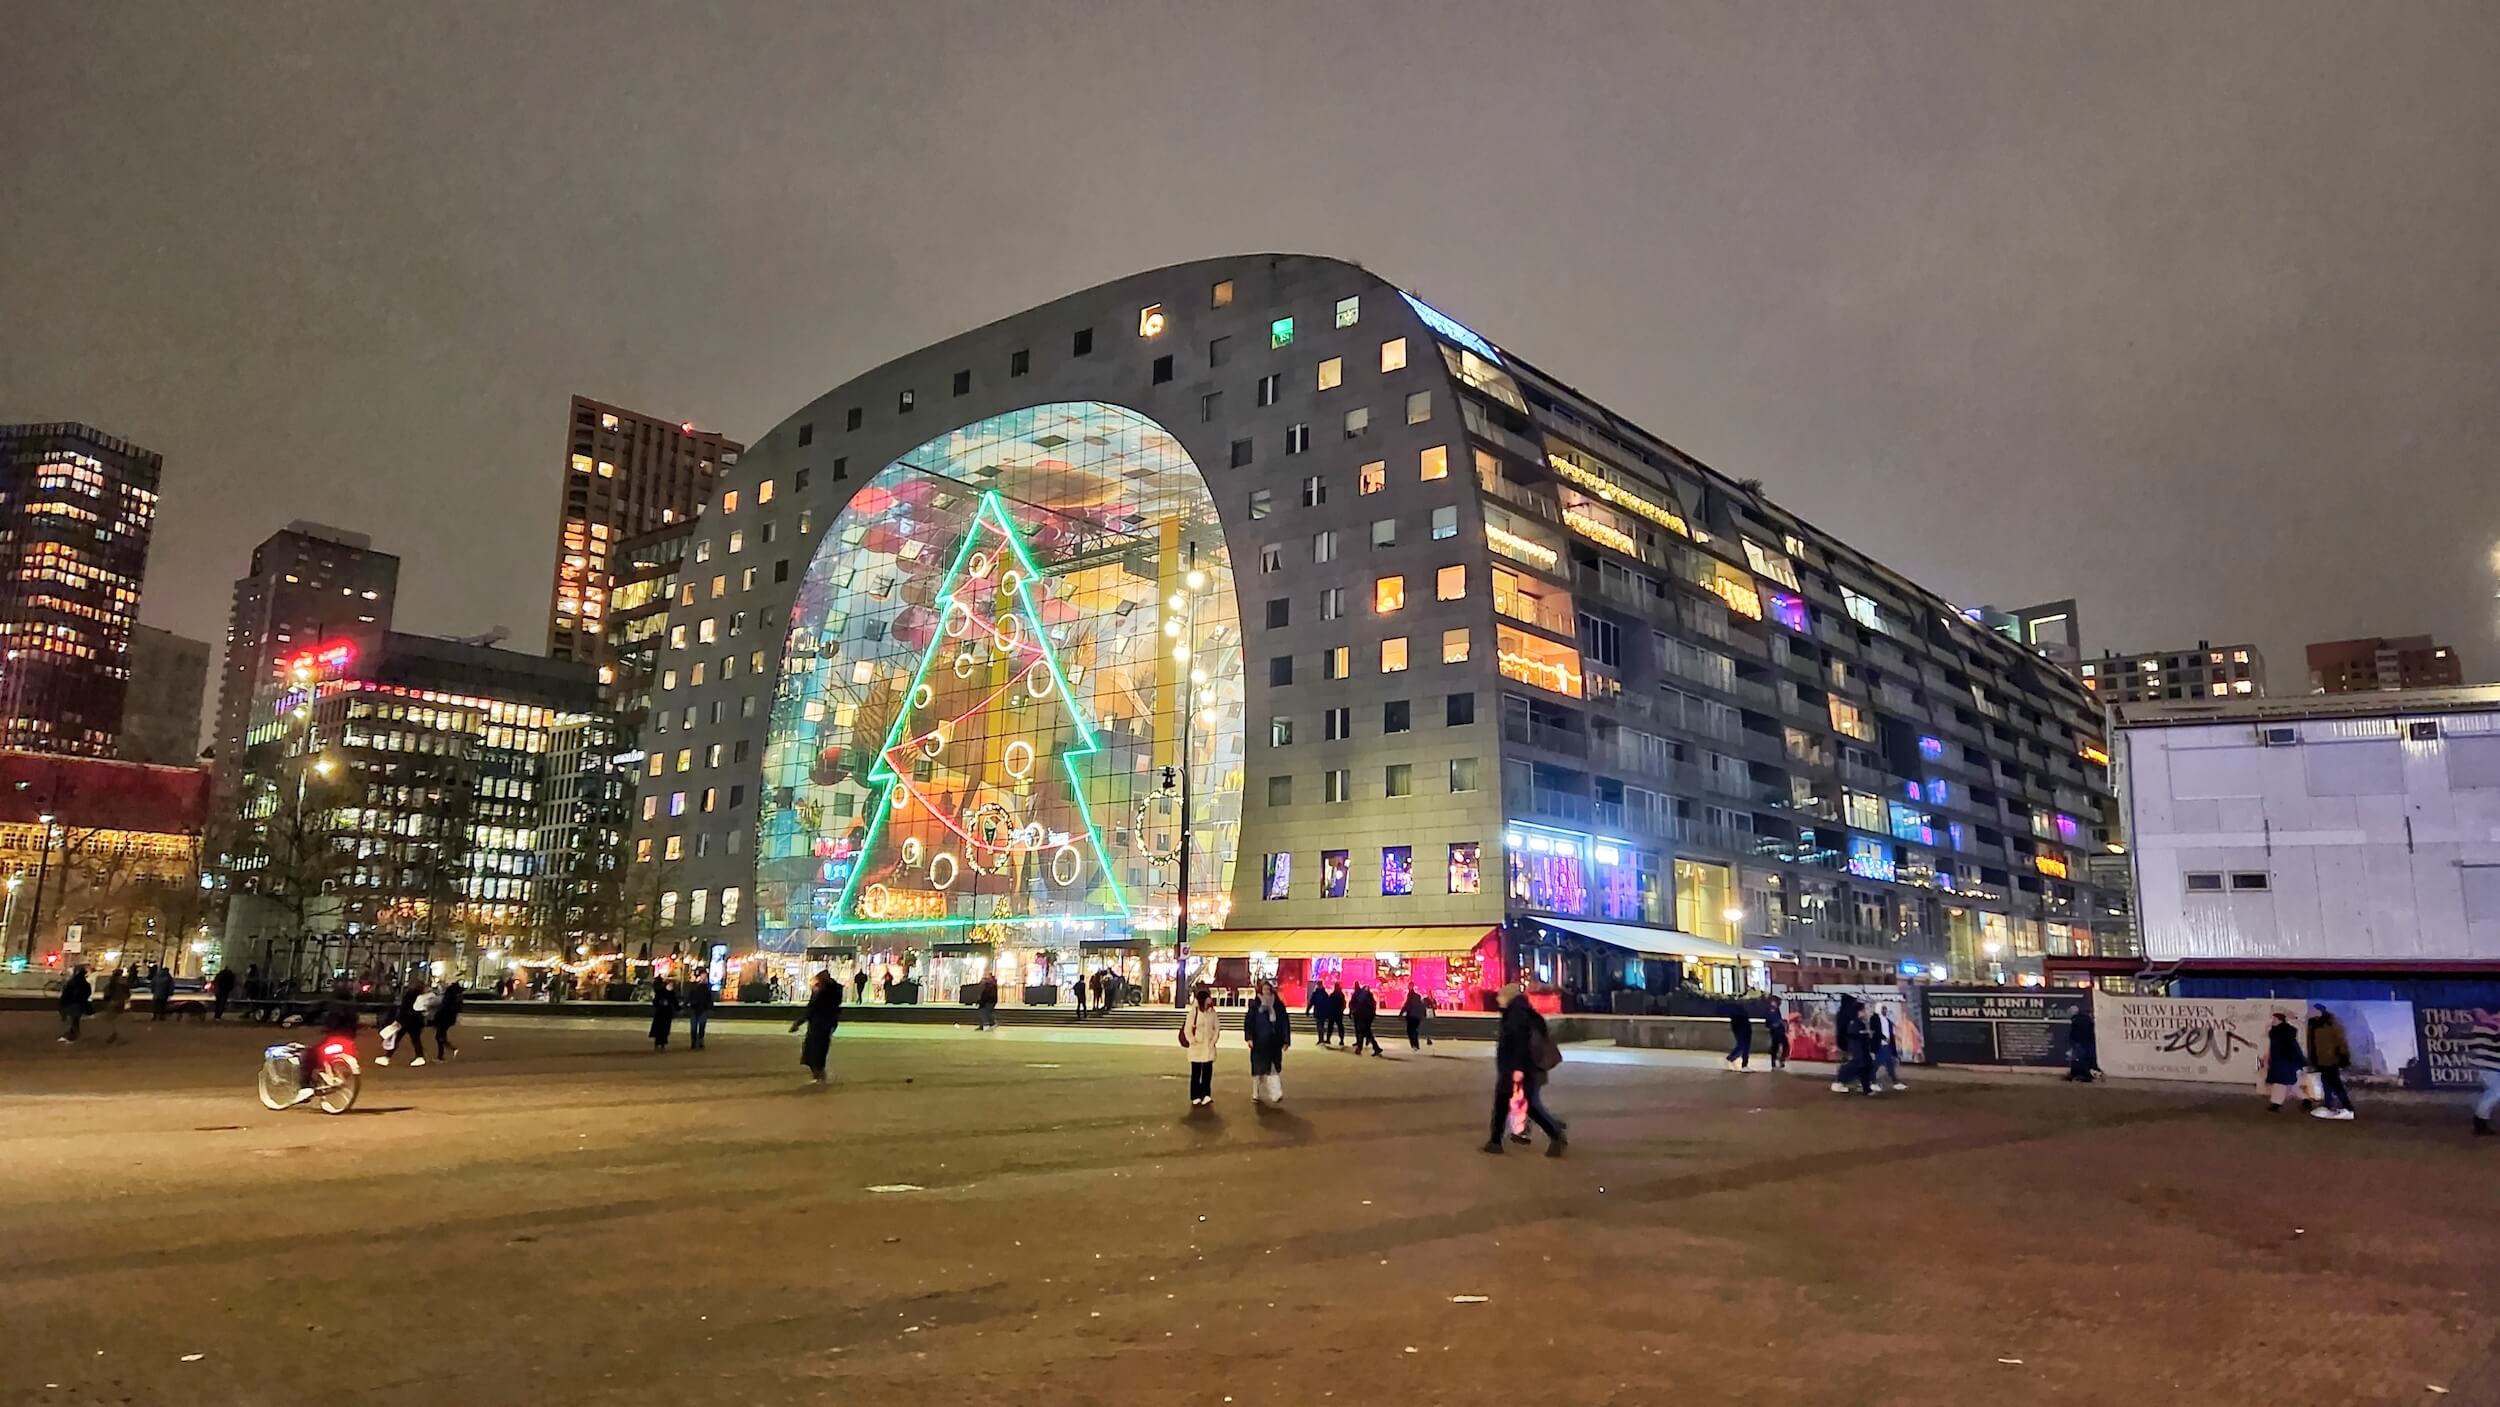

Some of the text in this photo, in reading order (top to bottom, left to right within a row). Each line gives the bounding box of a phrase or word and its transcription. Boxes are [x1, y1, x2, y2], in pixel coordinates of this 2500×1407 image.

[1997, 998, 2026, 1008] BENT
[2030, 998, 2044, 1008] IN
[1930, 1007, 1949, 1018] HET
[1952, 1007, 1980, 1018] HART
[1982, 1008, 2008, 1018] VAN
[2122, 1004, 2168, 1015] NIEUW
[2169, 1004, 2215, 1017] LEVEN
[2421, 1007, 2475, 1024] THUIS
[2124, 1017, 2138, 1028] IN
[2124, 1028, 2160, 1040] HART
[2424, 1023, 2450, 1038] OP
